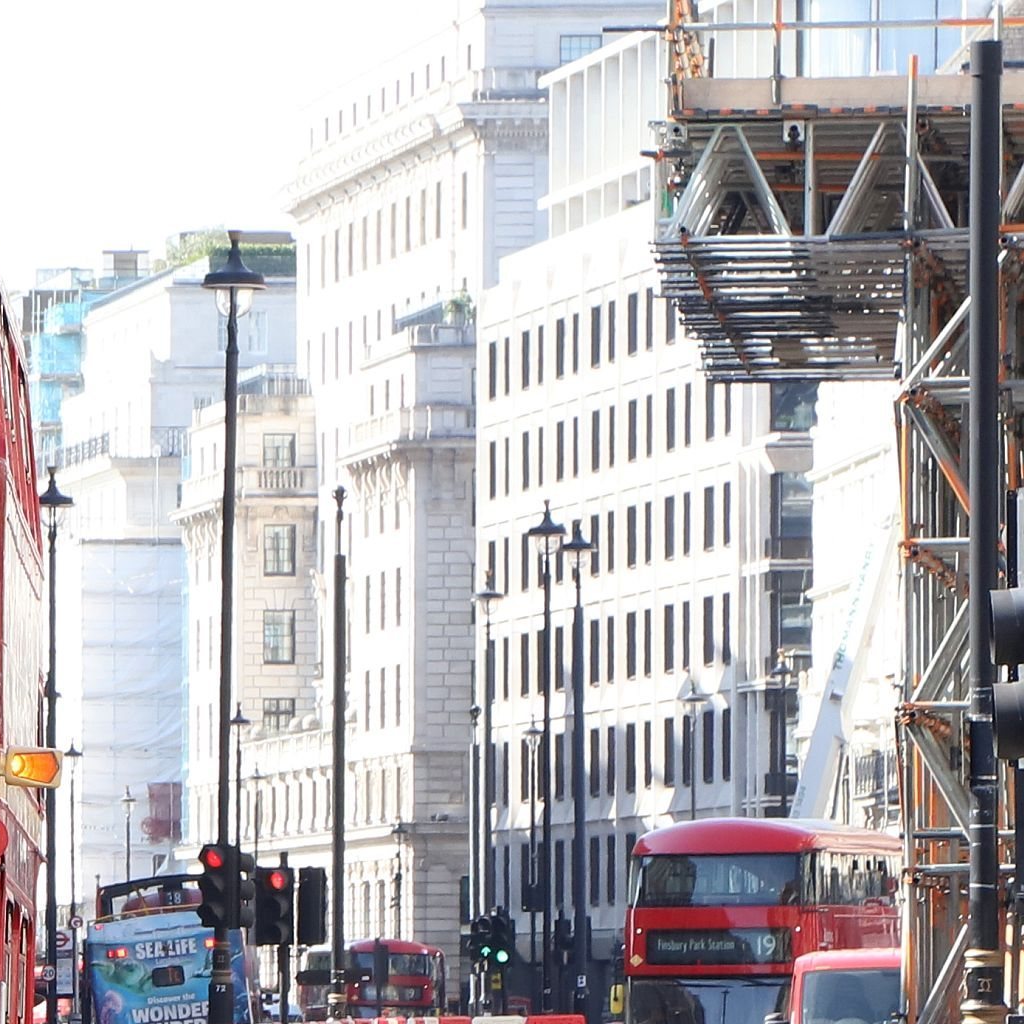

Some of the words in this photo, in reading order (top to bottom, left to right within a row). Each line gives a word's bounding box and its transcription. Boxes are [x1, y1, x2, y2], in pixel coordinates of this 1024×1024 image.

[135, 941, 165, 960] SEA
[657, 938, 687, 953] Finsbury
[688, 938, 705, 950] Park
[707, 938, 735, 950] Station
[756, 934, 776, 956] 19
[43, 969, 54, 978] 20
[215, 984, 226, 993] 72
